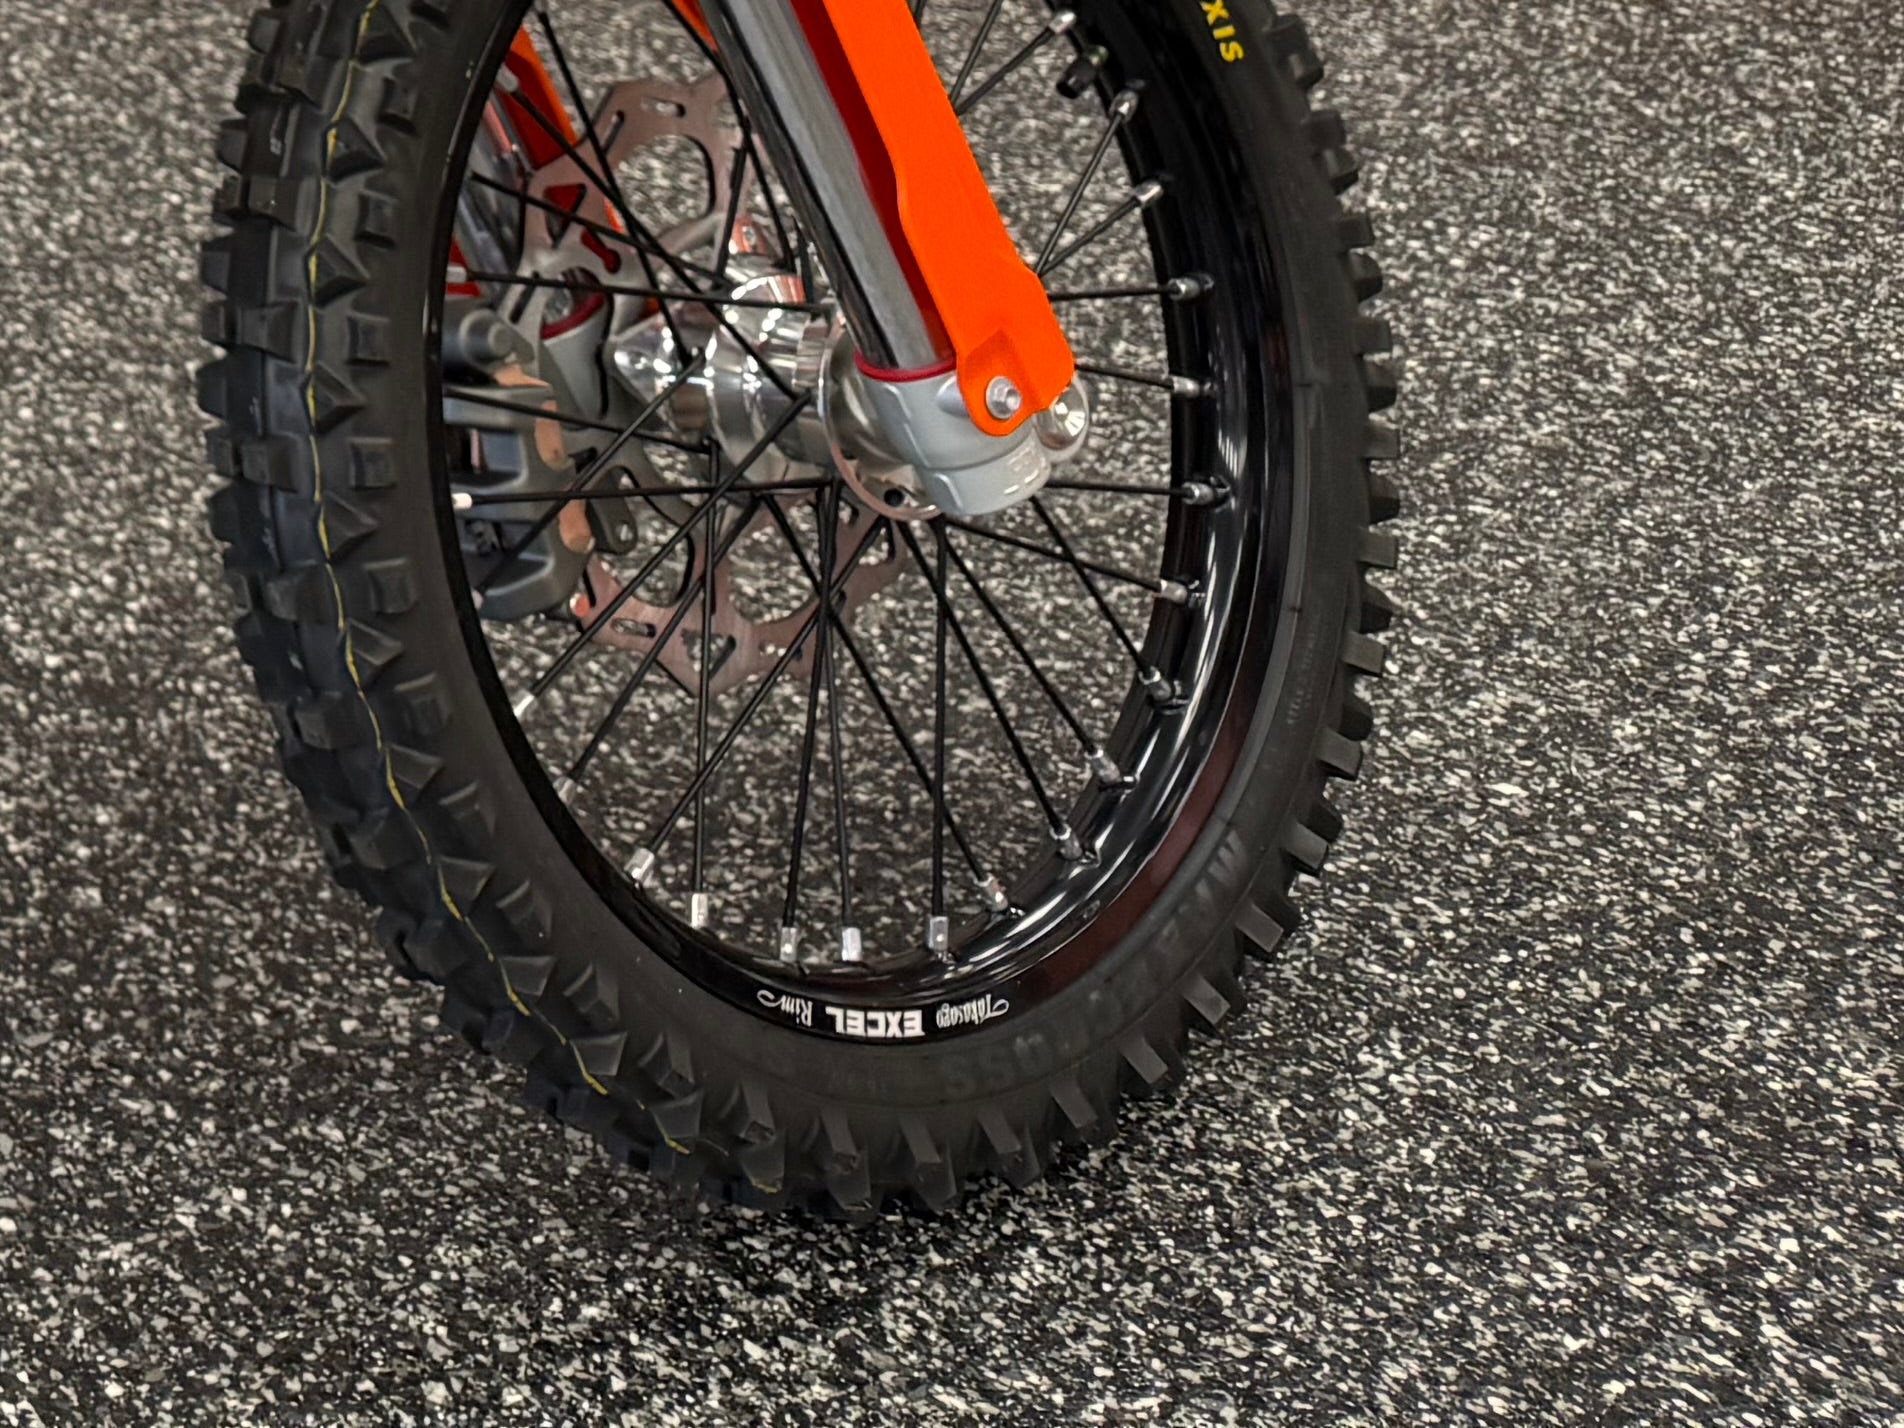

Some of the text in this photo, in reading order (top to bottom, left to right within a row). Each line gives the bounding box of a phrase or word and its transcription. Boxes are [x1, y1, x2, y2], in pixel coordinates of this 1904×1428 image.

[756, 989, 1010, 1039] Takasago EXCEL Rim
